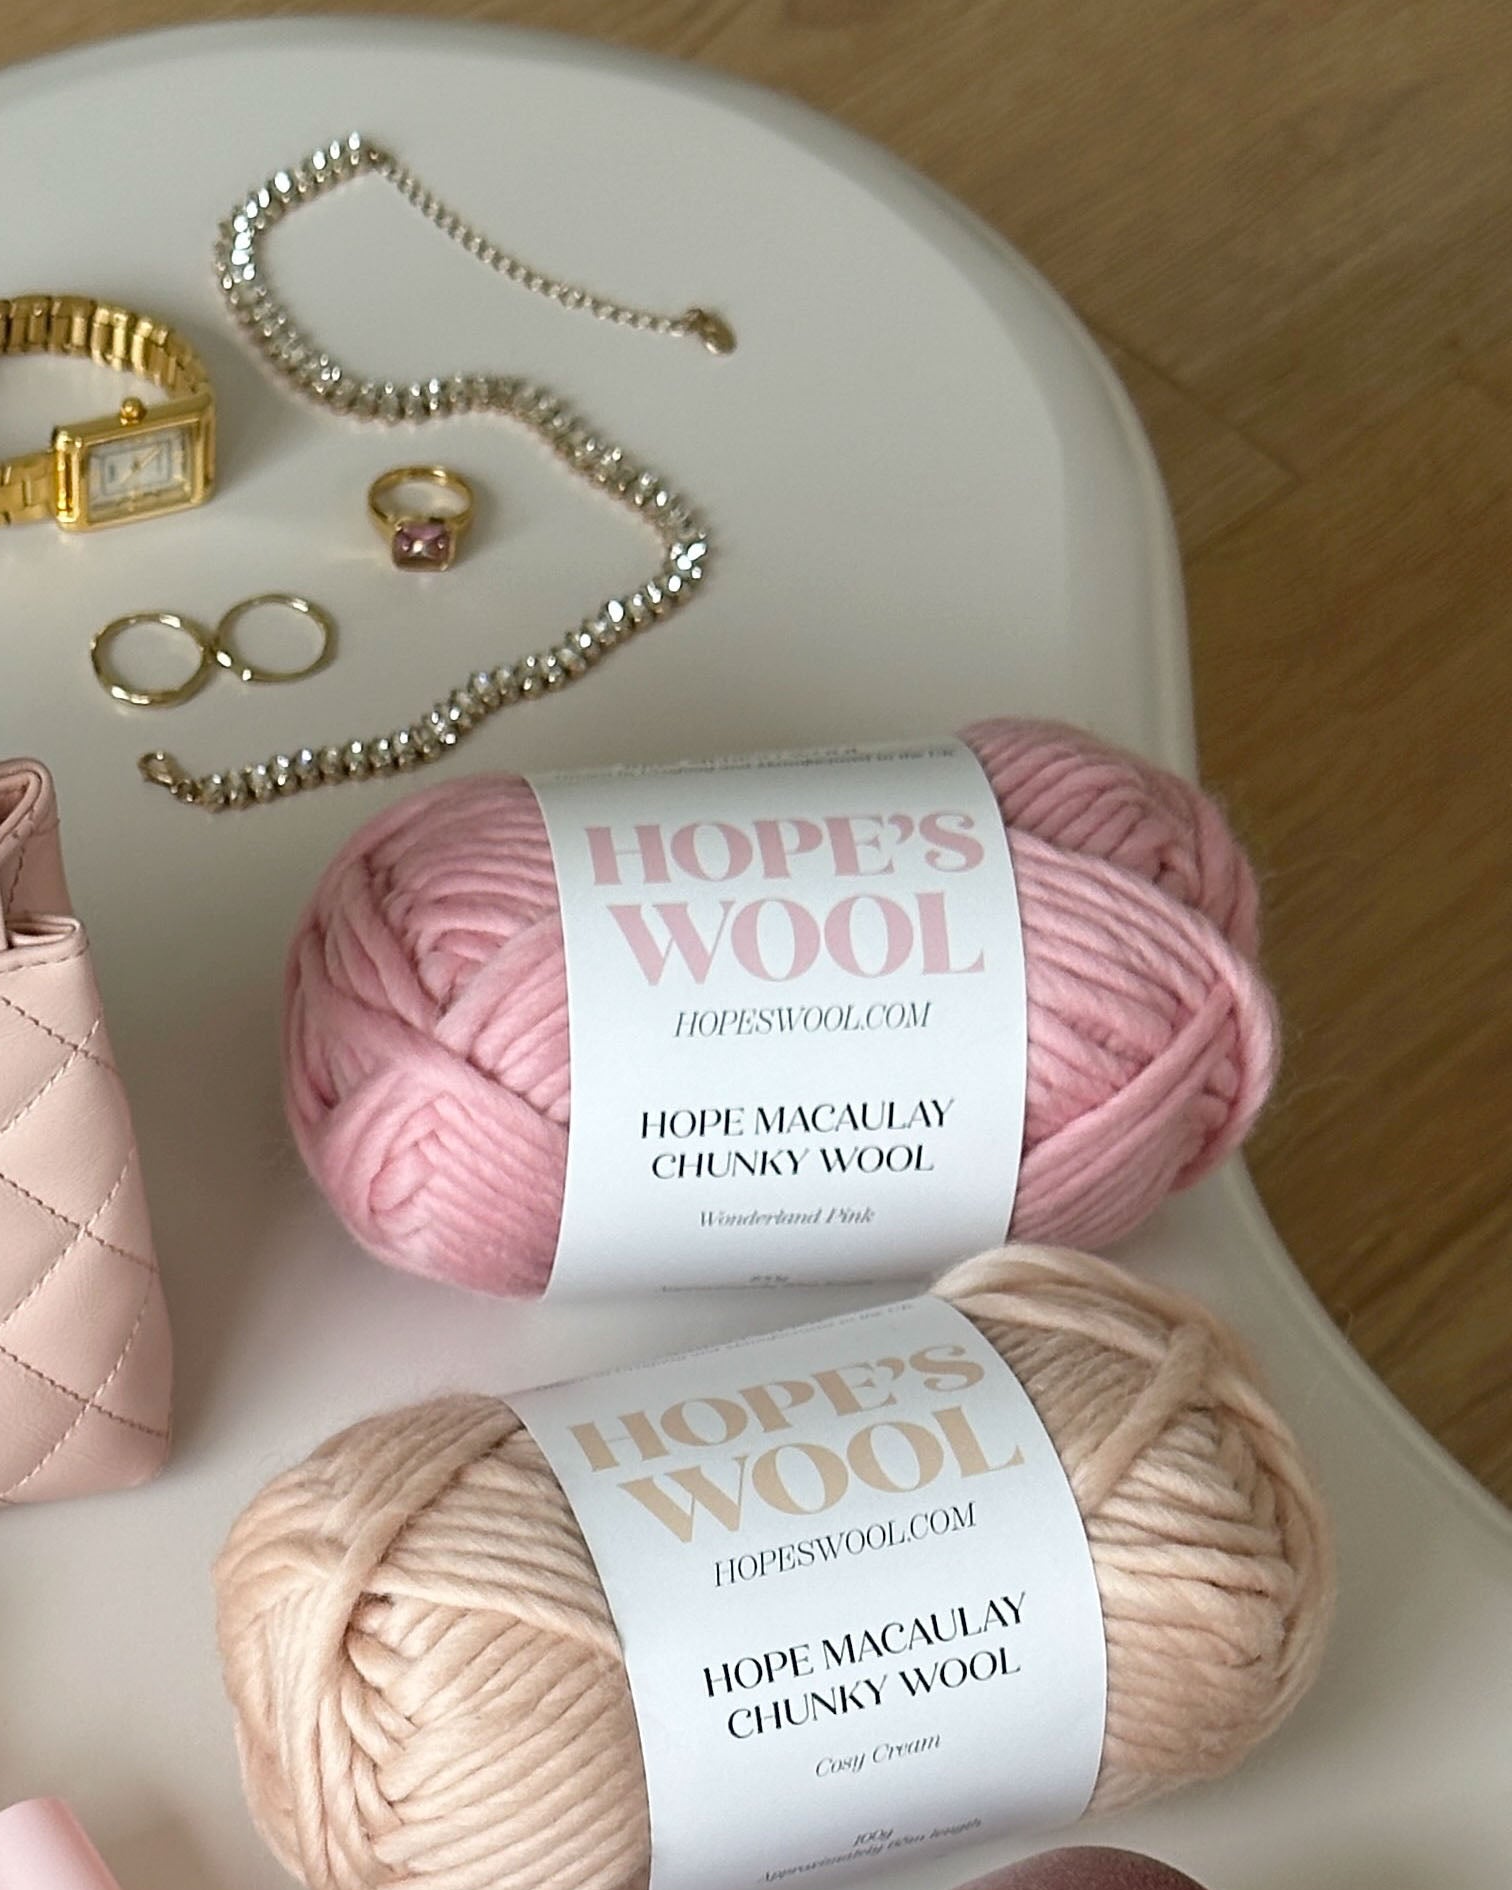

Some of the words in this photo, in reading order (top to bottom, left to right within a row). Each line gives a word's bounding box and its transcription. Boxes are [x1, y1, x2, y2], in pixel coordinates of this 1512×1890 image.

[584, 810, 985, 886] HOPE'S
[607, 891, 985, 987] WOOL
[674, 1002, 932, 1038] HOPESWOOL.COM
[641, 1107, 745, 1139] HOPE
[754, 1097, 955, 1134] MACAULAY
[651, 1148, 810, 1179] CHUNKY
[819, 1143, 935, 1174] WOOL
[699, 1206, 820, 1228] Wonderland
[825, 1206, 876, 1225] Pink
[567, 1344, 984, 1472] HOPE'S
[617, 1405, 1024, 1544] WOOL
[714, 1501, 977, 1588] HOPESWOOL.COM
[702, 1645, 815, 1699] HOPE
[822, 1592, 1028, 1672] MACAULAY
[727, 1675, 890, 1740] CHUNKY
[899, 1646, 1022, 1698] WOOL
[815, 1751, 866, 1778] Cosy
[872, 1733, 942, 1764] Cream
